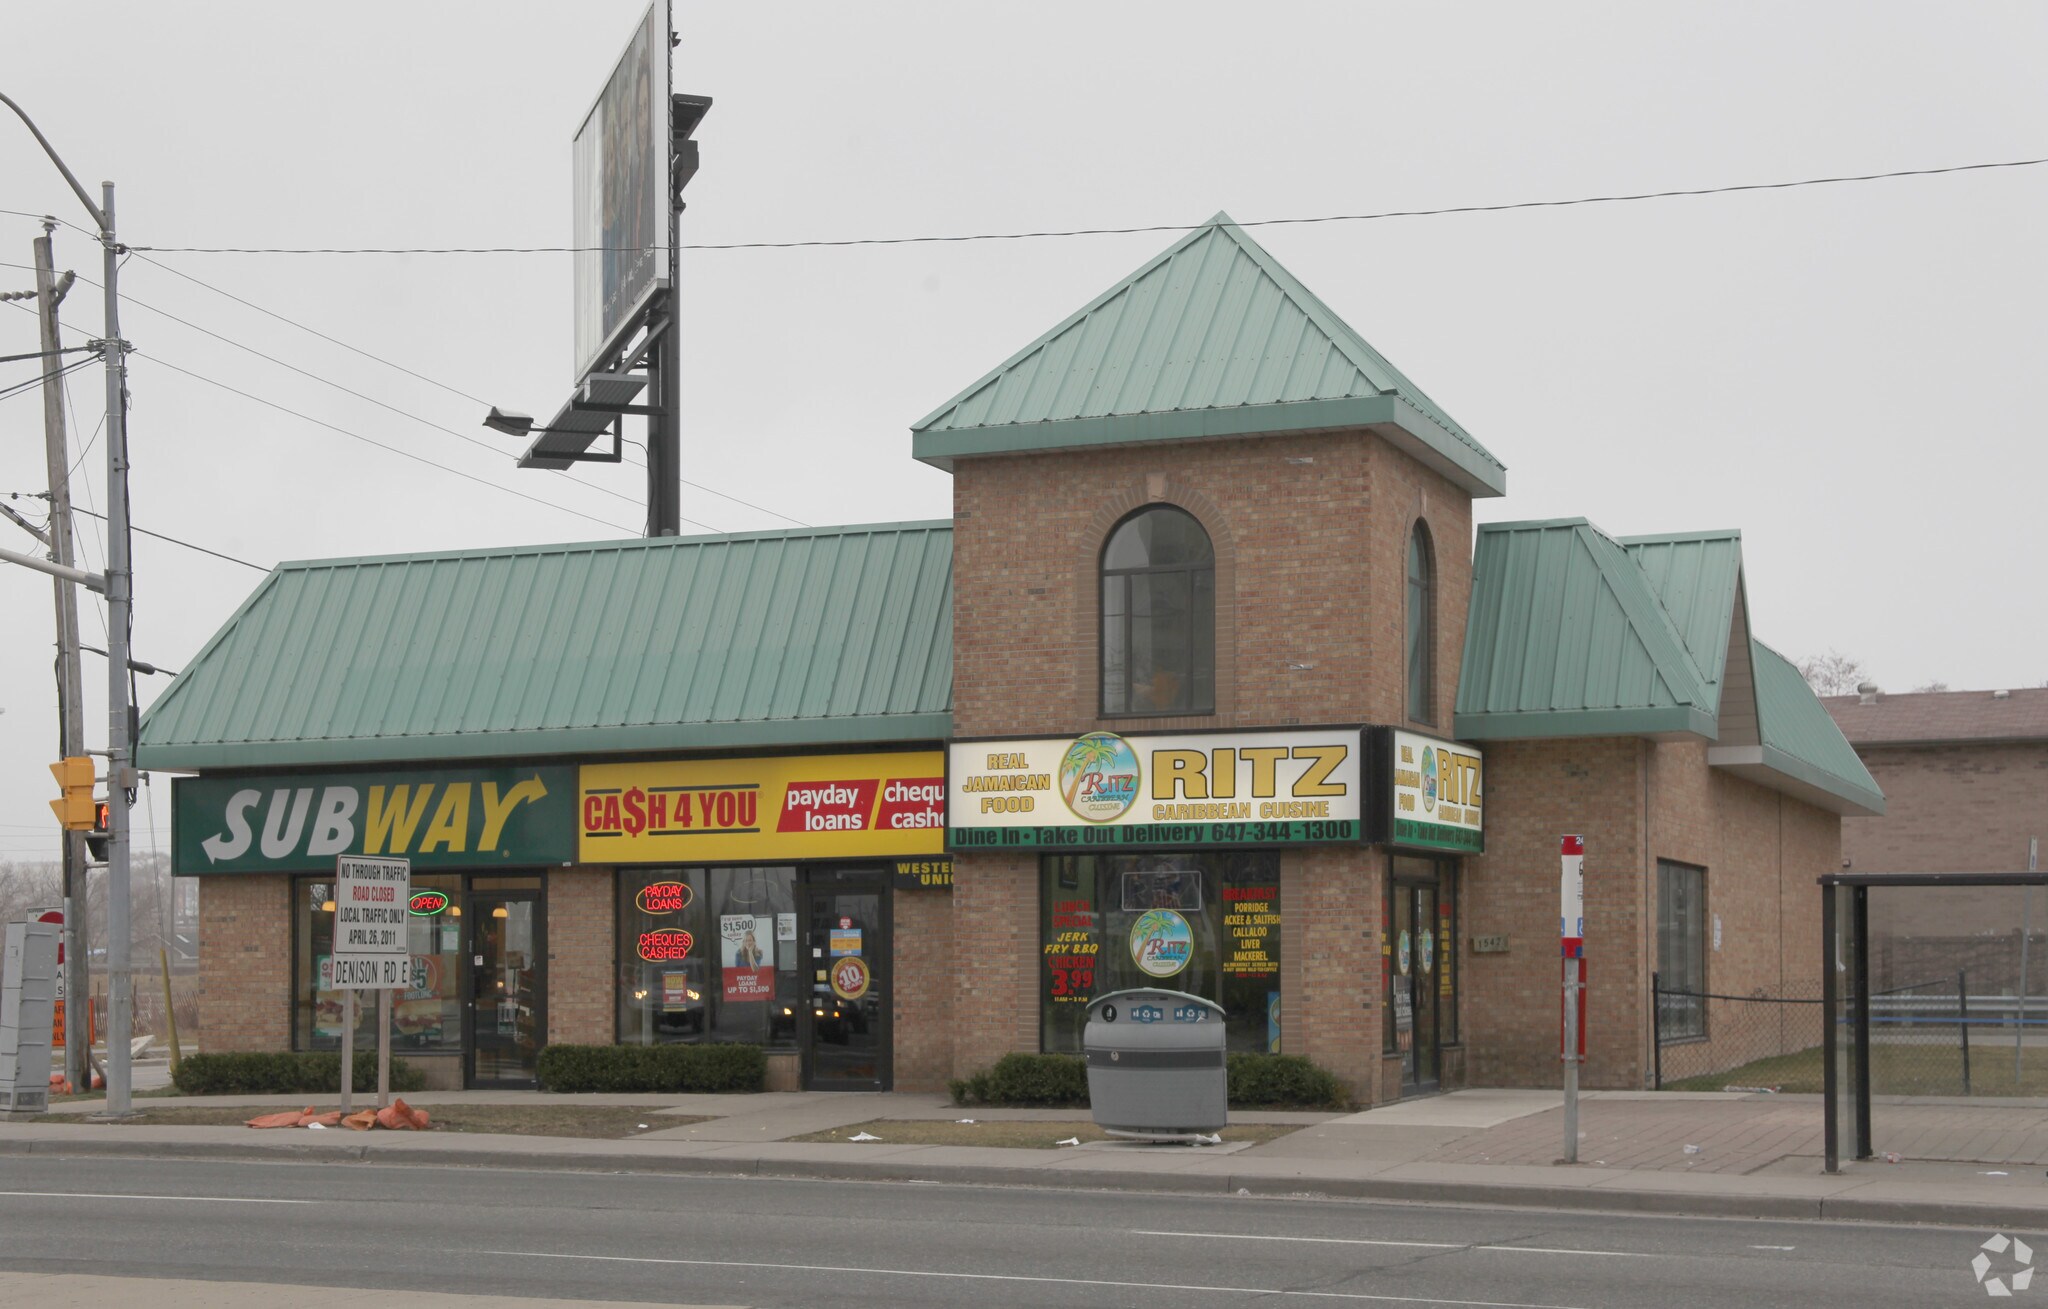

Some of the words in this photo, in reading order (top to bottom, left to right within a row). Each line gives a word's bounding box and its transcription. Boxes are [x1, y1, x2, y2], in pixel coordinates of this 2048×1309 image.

[987, 753, 1029, 770] REAL
[1152, 745, 1348, 800] RITZ
[1437, 748, 1480, 807] RITZ
[962, 774, 1050, 792] JAMAICAN
[788, 784, 859, 810] payday
[981, 796, 1034, 814] FOOD
[201, 773, 548, 864] SUBWAY
[584, 786, 666, 838] CA$H
[674, 793, 692, 828] 4
[698, 791, 757, 827] YOU
[1153, 802, 1251, 820] CARIBBEAN
[1260, 801, 1329, 818] CUISINE
[805, 811, 862, 830] loans
[956, 827, 997, 845] Dine
[1002, 827, 1020, 844] In
[1033, 826, 1078, 844] Take
[1083, 825, 1116, 843] Out
[1123, 824, 1204, 843] Delivery
[341, 863, 350, 879] NO
[352, 864, 381, 880] THROUGH
[383, 865, 407, 881] TRAFFIC
[353, 885, 370, 901] ROAD
[372, 886, 395, 902] CLOSED
[645, 885, 683, 897] PAYDAY
[411, 897, 442, 909] OPEN
[647, 899, 683, 910] LOANS
[1235, 903, 1269, 912] PORRIDGE
[340, 907, 360, 923] LOCAL
[362, 908, 387, 924] TRAFFIC
[389, 908, 405, 924] ONLY
[1224, 915, 1245, 925] ACKEE
[1253, 914, 1281, 924] SALTFISH
[723, 920, 753, 932] $1,500
[1233, 927, 1267, 937] CALLALOO
[349, 929, 367, 945] APRIL
[381, 930, 396, 945] 2011
[640, 933, 690, 946] CHEQUES
[1057, 932, 1088, 942] JERK
[1241, 939, 1260, 949] LIVER
[642, 946, 686, 959] CASHED
[1045, 944, 1069, 954] FRY
[1234, 951, 1268, 961] MACKEREL
[336, 961, 378, 984] DENISON
[384, 961, 397, 984] RD
[402, 961, 408, 984] E
[839, 966, 860, 986] 10
[1051, 969, 1094, 995] 3.99
